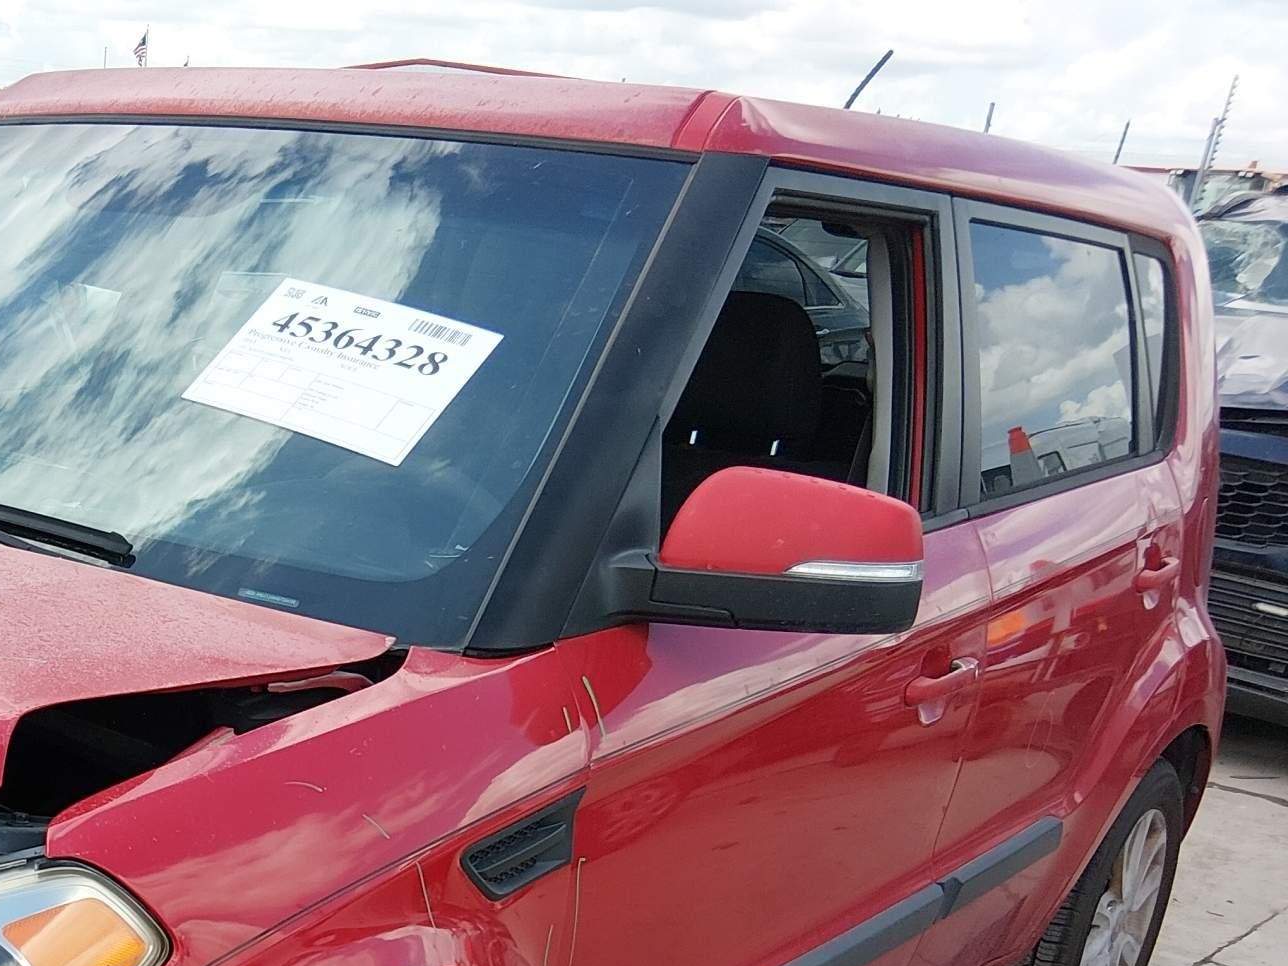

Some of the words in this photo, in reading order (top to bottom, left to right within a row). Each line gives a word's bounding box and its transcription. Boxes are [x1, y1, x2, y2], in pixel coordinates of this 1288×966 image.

[248, 328, 298, 347] Progressive
[298, 341, 334, 357] Casualty
[335, 351, 382, 371] Insurance
[272, 311, 449, 377] 45364328
